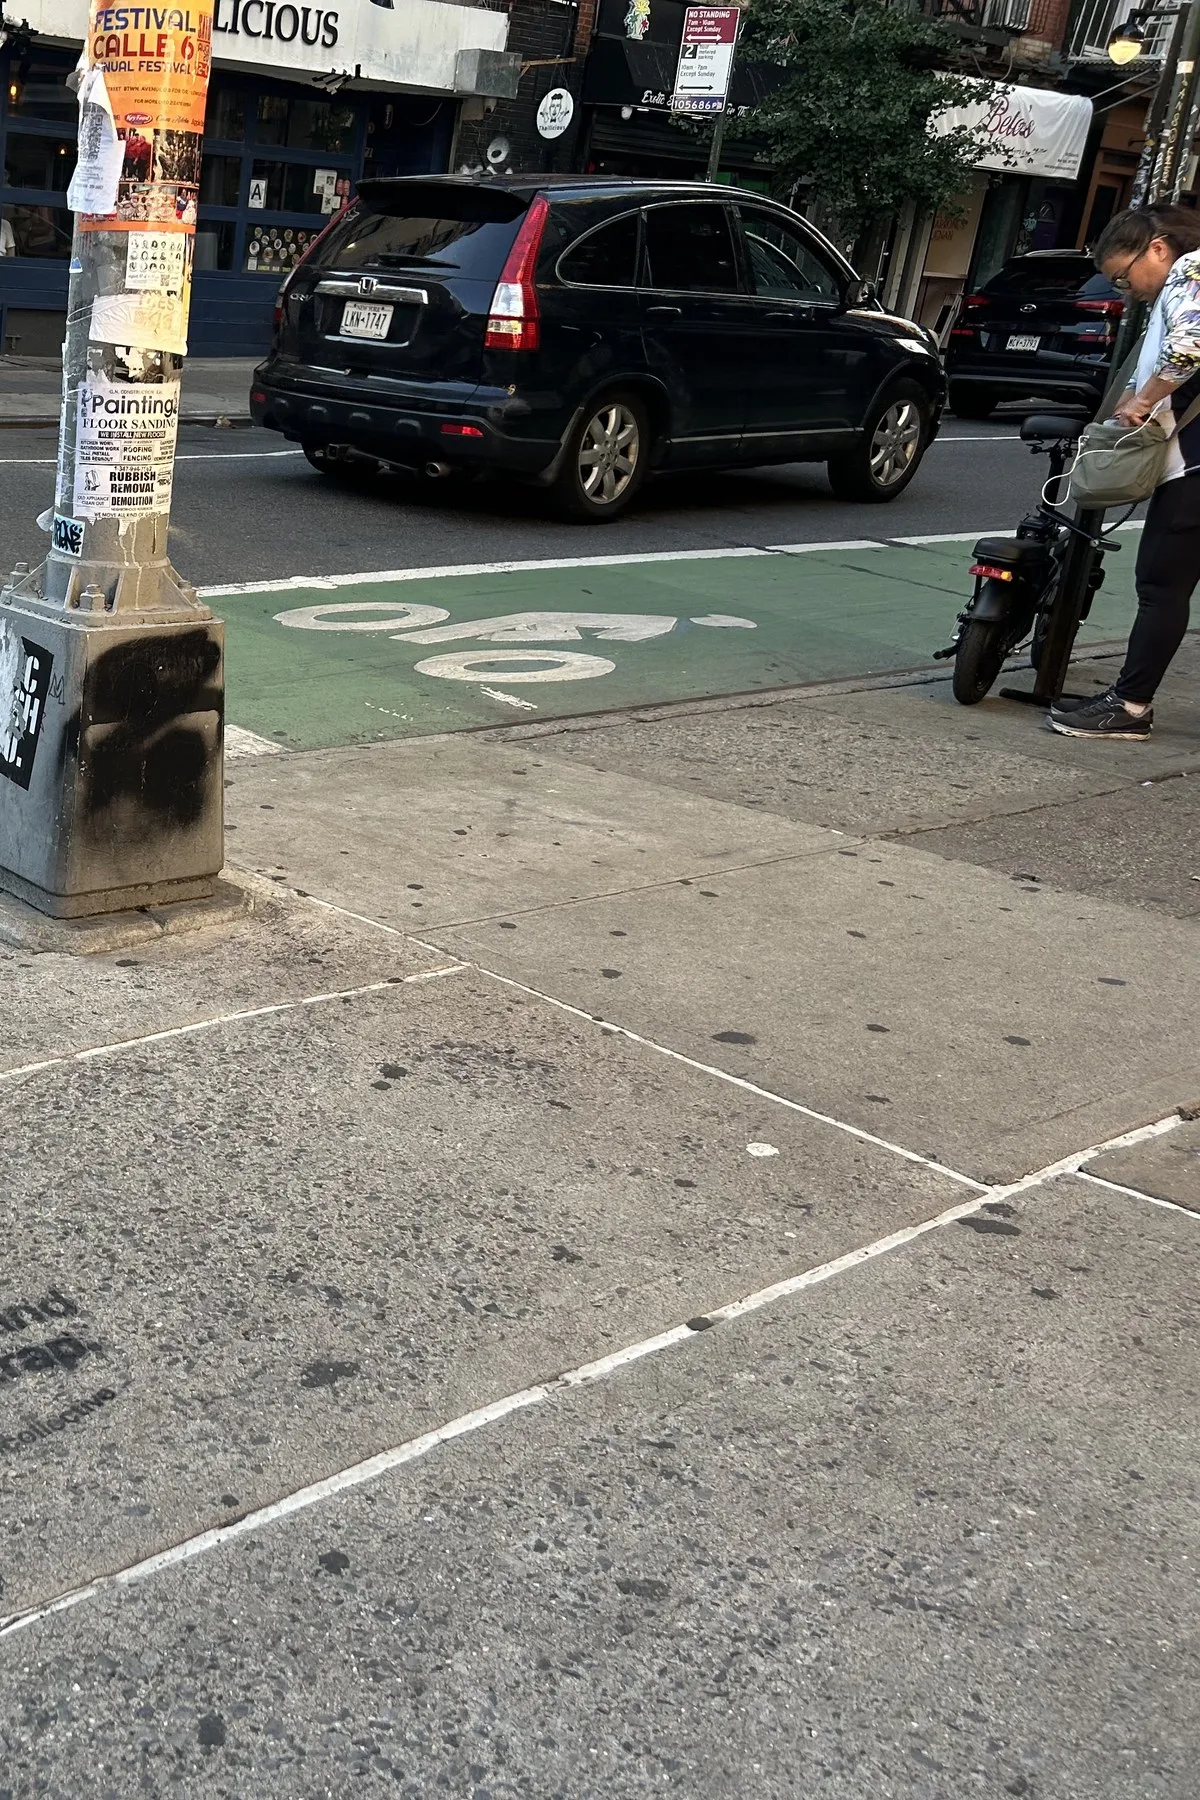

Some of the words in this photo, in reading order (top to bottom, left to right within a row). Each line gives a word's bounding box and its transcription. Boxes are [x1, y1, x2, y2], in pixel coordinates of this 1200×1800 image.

[688, 10, 698, 18] NO
[699, 10, 731, 18] STANDING
[94, 8, 196, 33] FESTIVAL
[212, 0, 339, 48] LICIOUS
[93, 33, 168, 59] CALLE
[181, 35, 195, 60] 6
[684, 44, 694, 57] 2
[674, 100, 711, 110] 105686
[251, 183, 262, 201] A
[92, 394, 174, 418] Painting
[82, 418, 128, 430] FLOOR
[131, 418, 176, 430] SANDING
[109, 471, 156, 482] RUBBISH
[111, 483, 155, 493] REMOVAL
[111, 496, 153, 506] DEMOLITION
